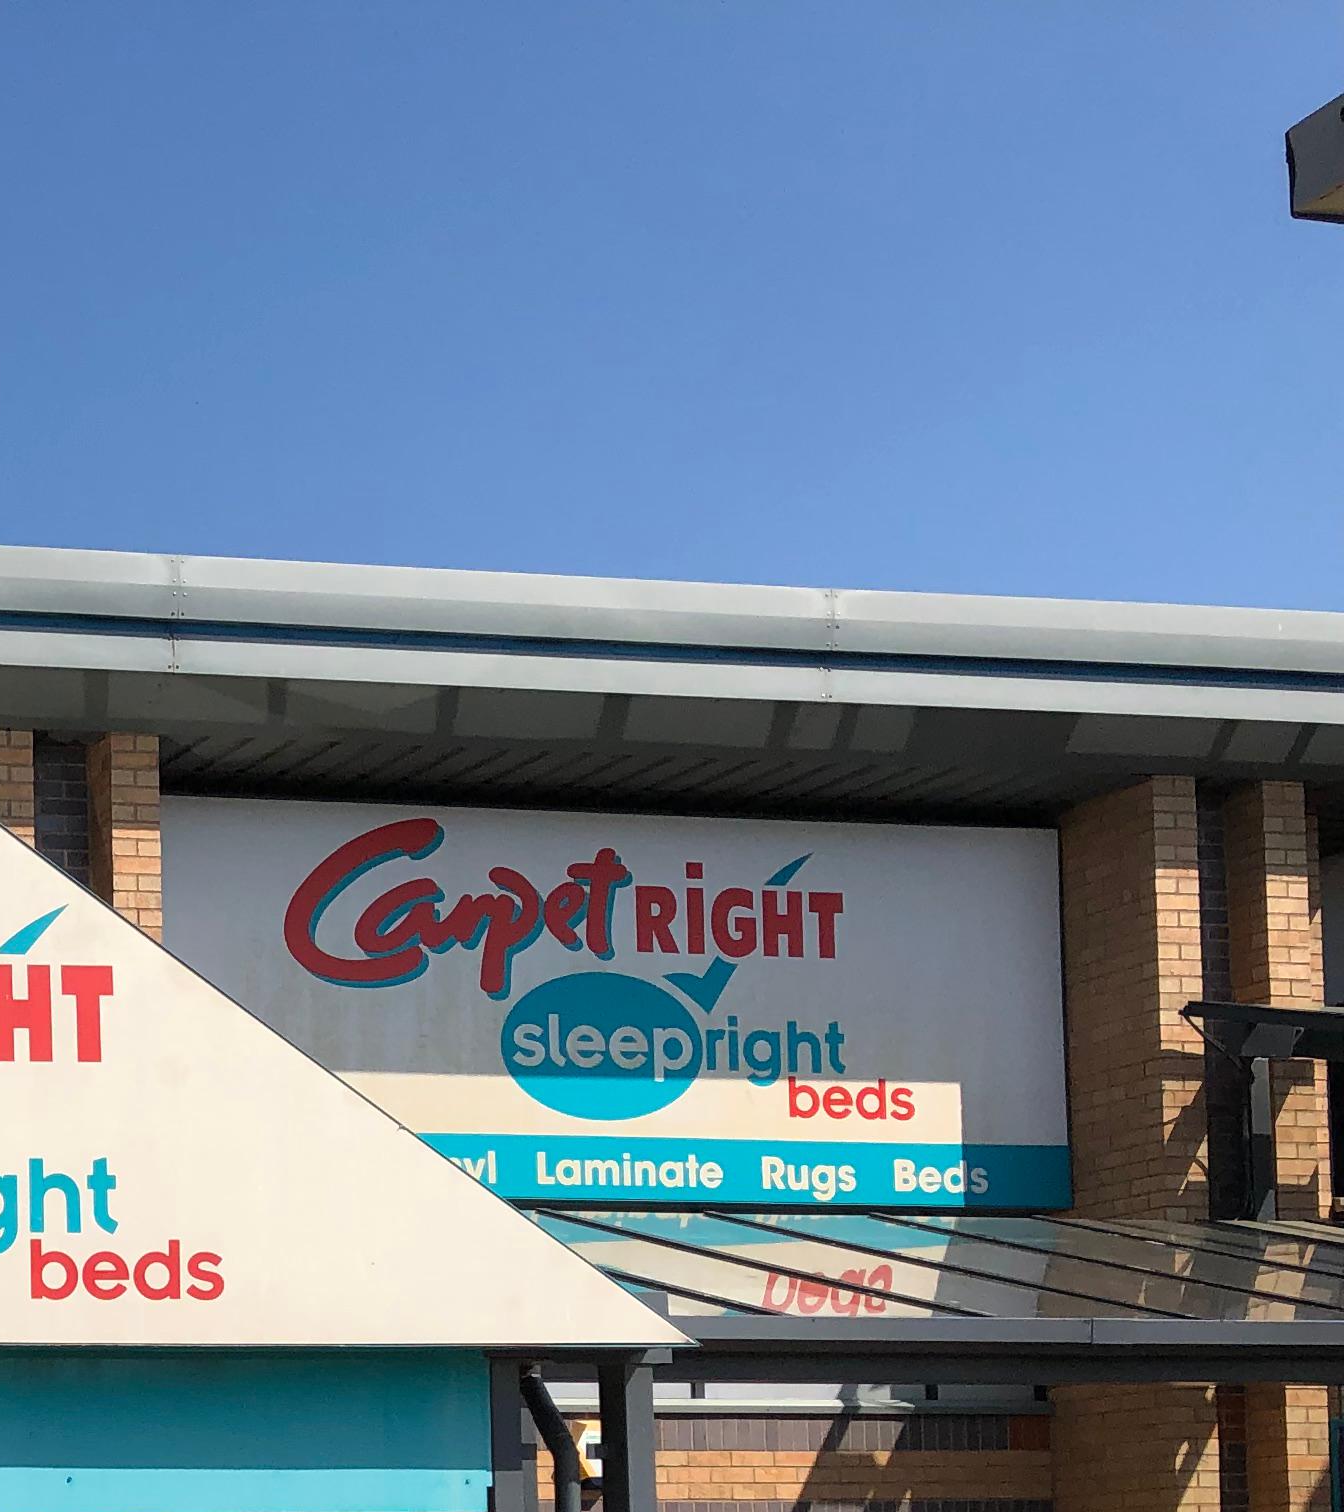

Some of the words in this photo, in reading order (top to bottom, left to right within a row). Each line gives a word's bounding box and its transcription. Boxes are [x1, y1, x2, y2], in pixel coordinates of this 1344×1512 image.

[788, 1077, 915, 1120] beds
[537, 1151, 723, 1189] Laminate
[762, 1156, 856, 1201] Rugs
[893, 1160, 988, 1194] Beds
[31, 1240, 224, 1301] beds
